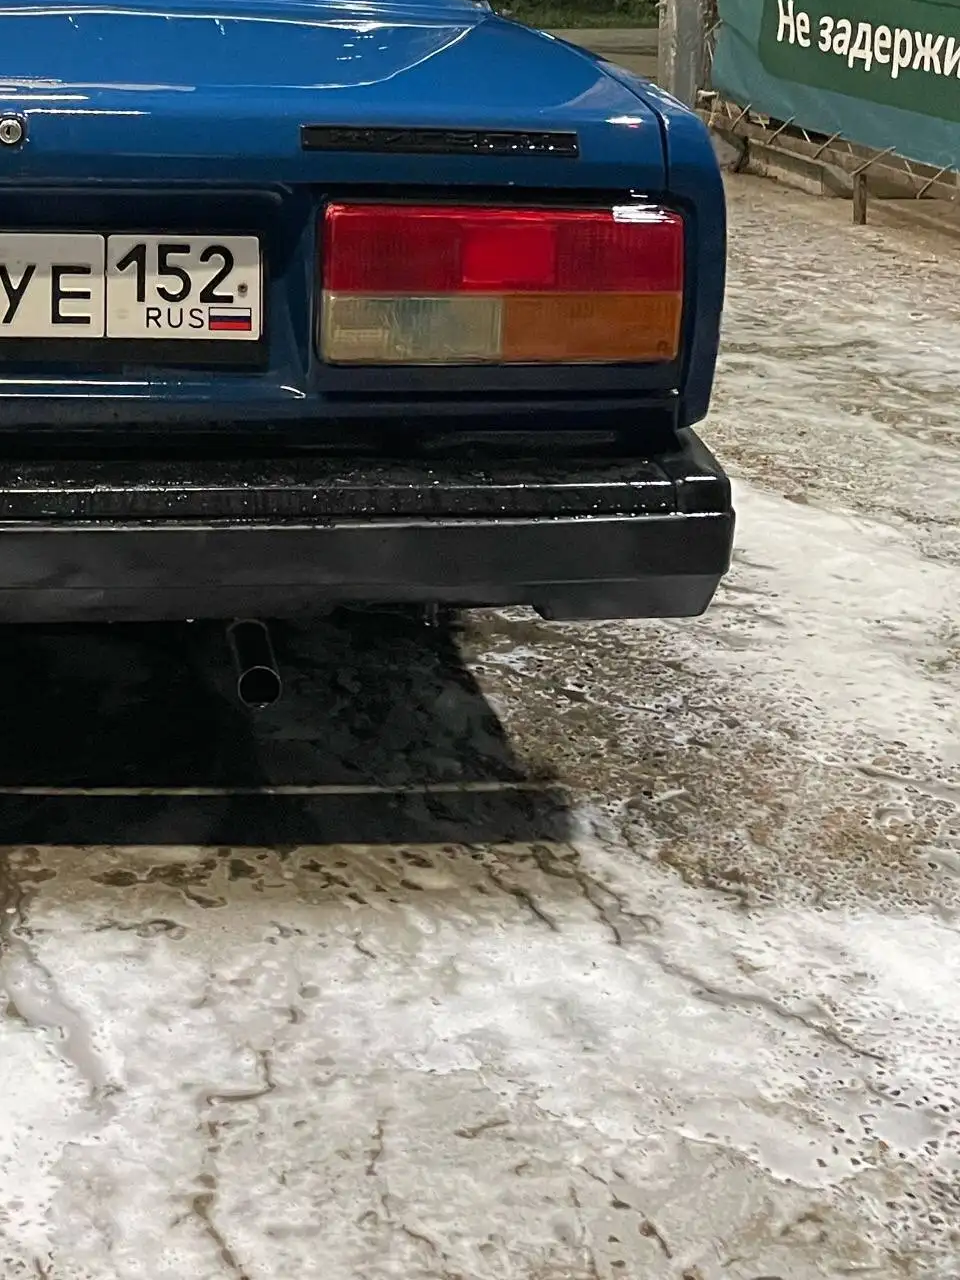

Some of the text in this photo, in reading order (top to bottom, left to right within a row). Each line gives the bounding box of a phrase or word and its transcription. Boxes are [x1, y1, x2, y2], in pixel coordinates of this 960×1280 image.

[818, 15, 960, 79] задержи
[115, 243, 235, 304] 152
[145, 307, 205, 329] RUS
